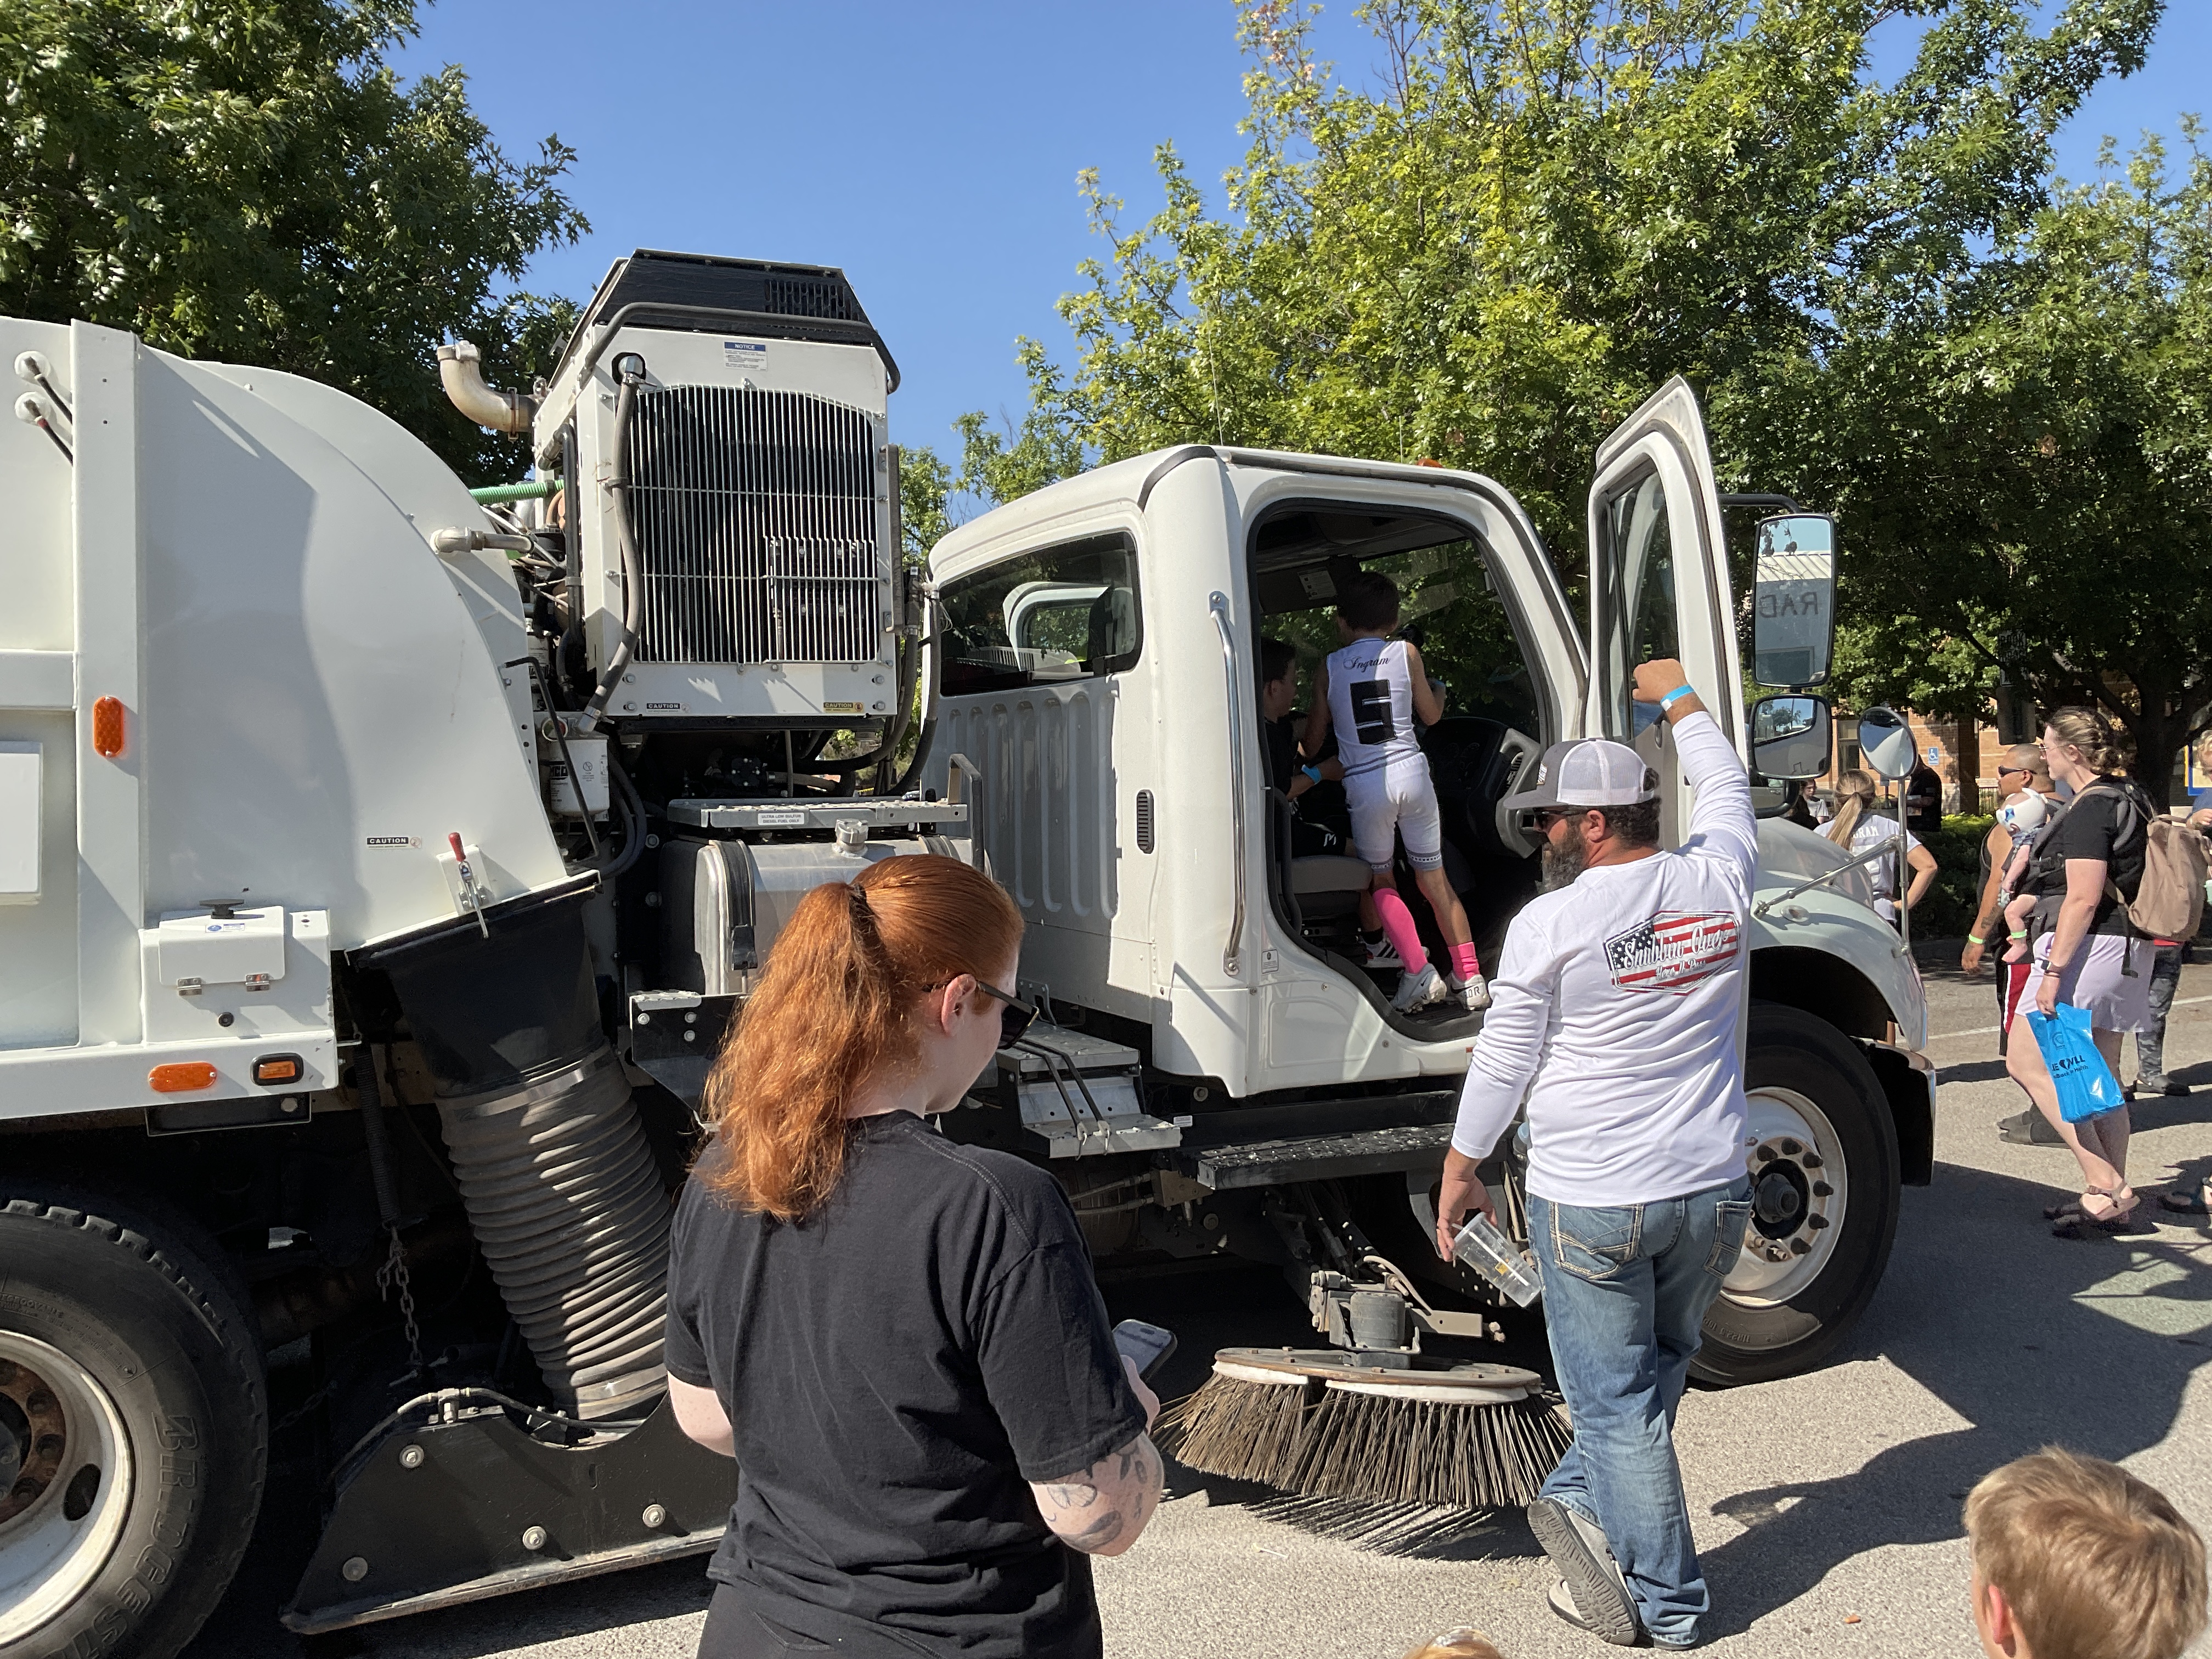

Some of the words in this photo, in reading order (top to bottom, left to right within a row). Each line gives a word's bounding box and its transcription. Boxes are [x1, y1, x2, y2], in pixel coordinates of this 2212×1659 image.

[1344, 656, 1391, 673] Ingram
[1350, 679, 1397, 745] 5
[44, 1411, 198, 1659] BRIDGEST
